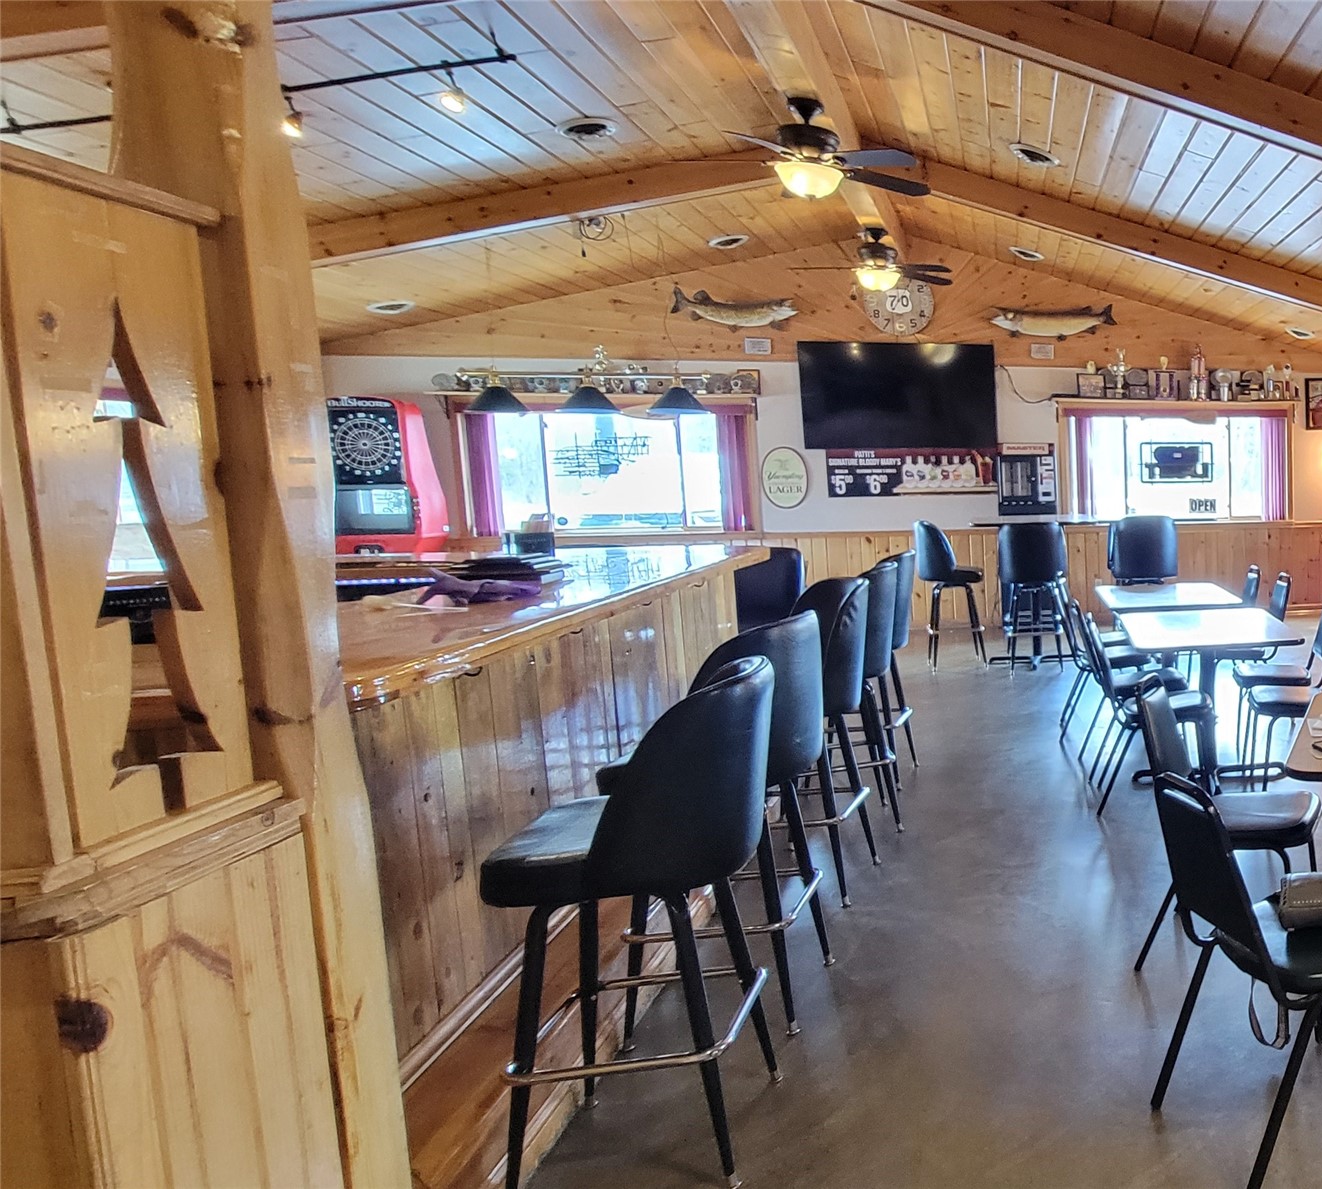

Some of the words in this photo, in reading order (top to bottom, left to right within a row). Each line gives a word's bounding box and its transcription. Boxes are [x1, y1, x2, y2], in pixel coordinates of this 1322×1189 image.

[917, 284, 924, 293] 2
[888, 294, 909, 307] 70
[873, 309, 880, 318] 8
[918, 310, 926, 318] 4
[882, 318, 890, 330] 7
[910, 318, 917, 328] 5
[859, 458, 880, 466] BLOODY
[881, 458, 901, 466] MARY'S
[769, 486, 803, 494] LAGER
[1190, 499, 1216, 511] OPEN
